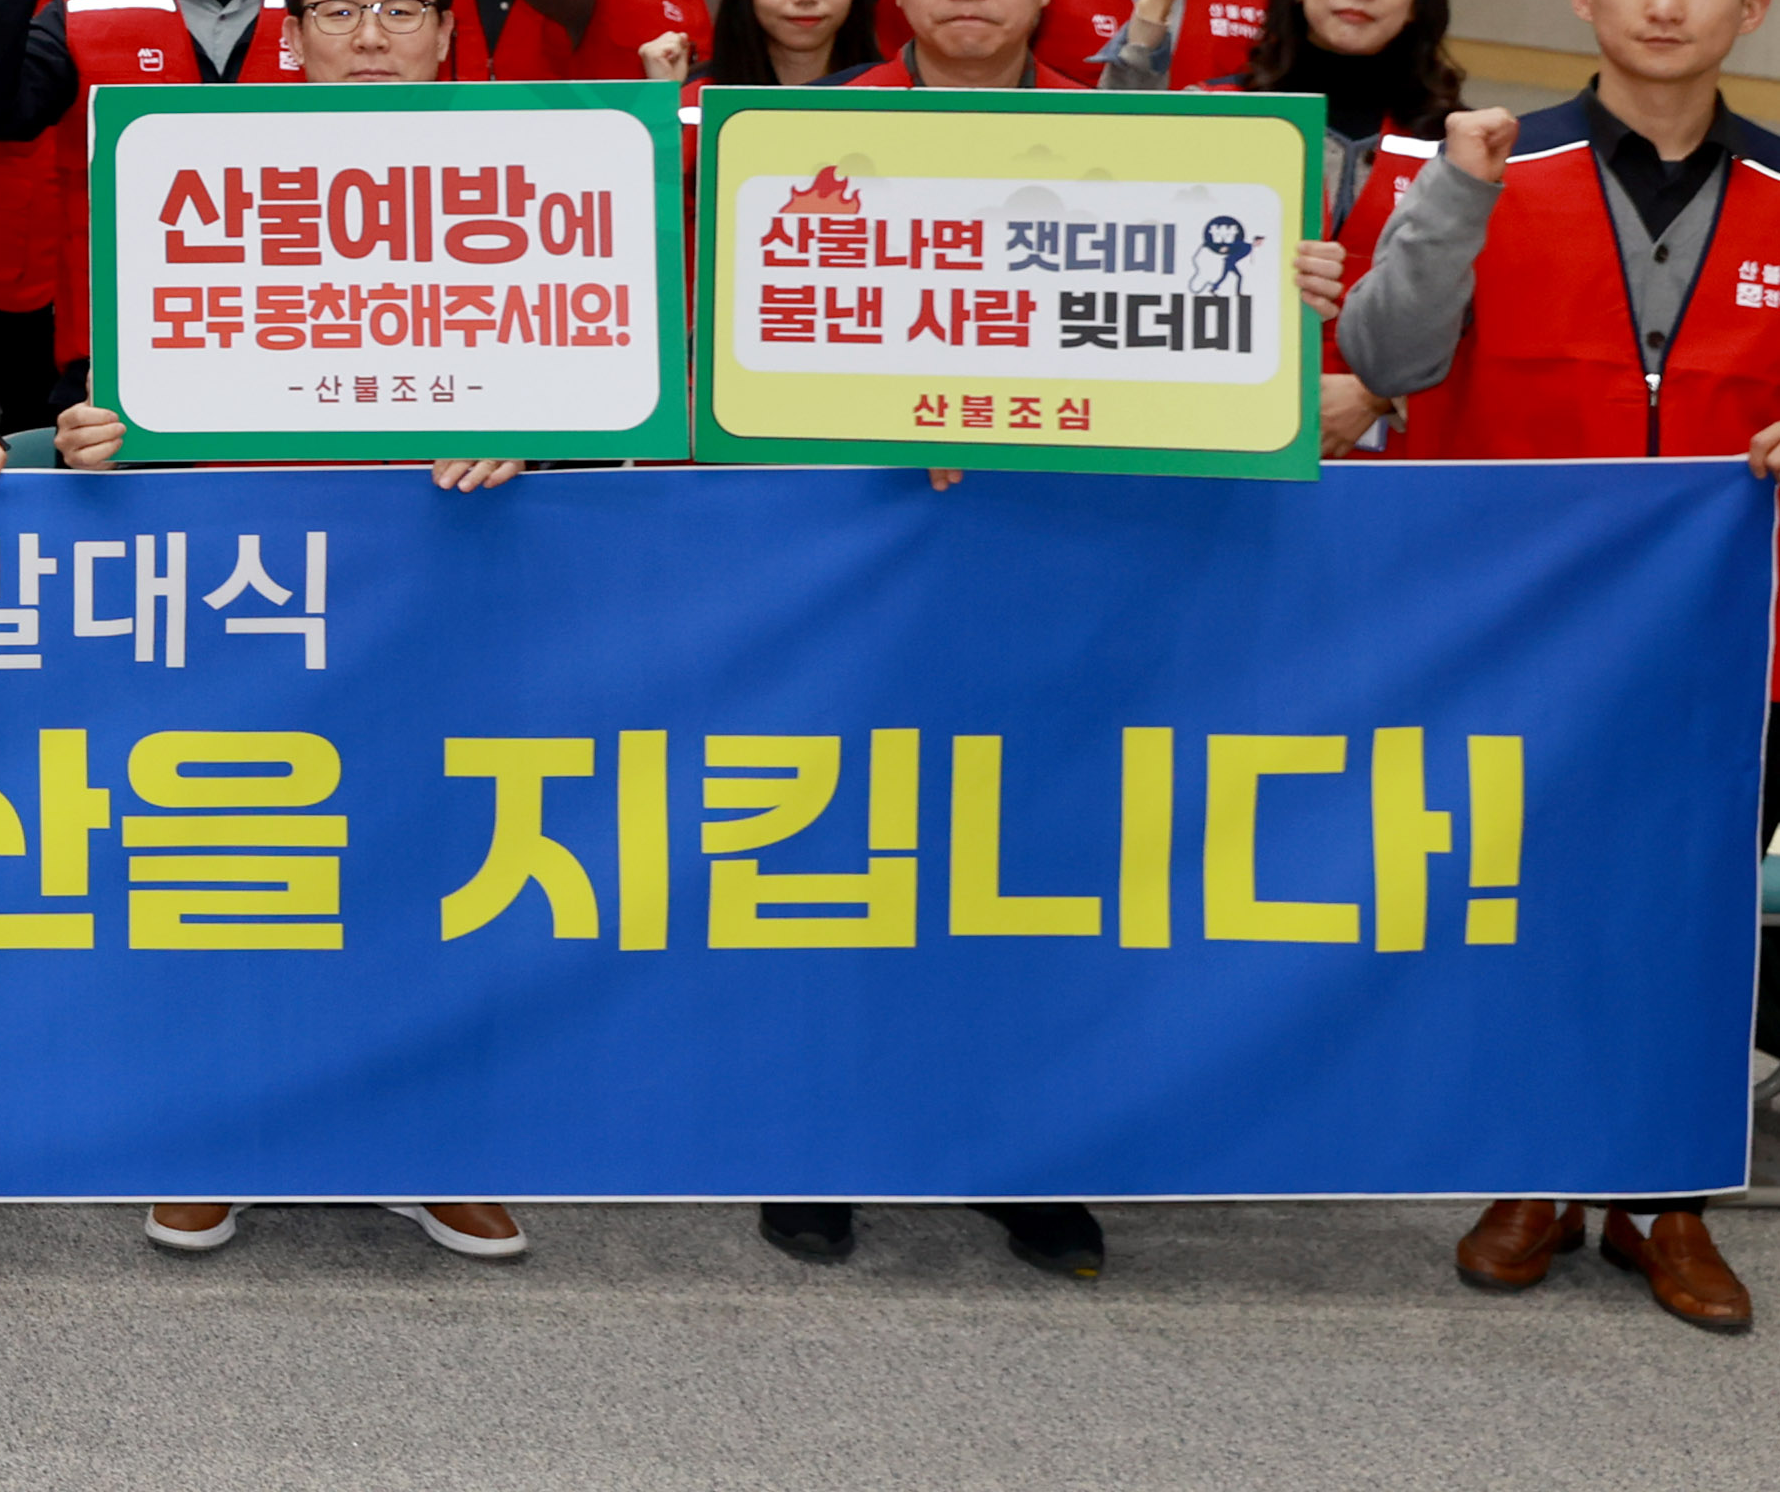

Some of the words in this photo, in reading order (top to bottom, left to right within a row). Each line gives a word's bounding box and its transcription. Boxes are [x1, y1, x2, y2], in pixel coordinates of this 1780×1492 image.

[158, 164, 613, 267] 산불예방에
[759, 216, 985, 272] 산불나면
[1005, 220, 1176, 275] 잿더미
[151, 285, 243, 350] 모두
[253, 282, 631, 351] 동참해주세요!
[758, 284, 884, 345] 불낸
[906, 287, 1038, 348] 사람
[1058, 291, 1254, 355] 빚더미
[913, 393, 1093, 431] 산불조심
[442, 727, 1524, 952] 지킵니다!
